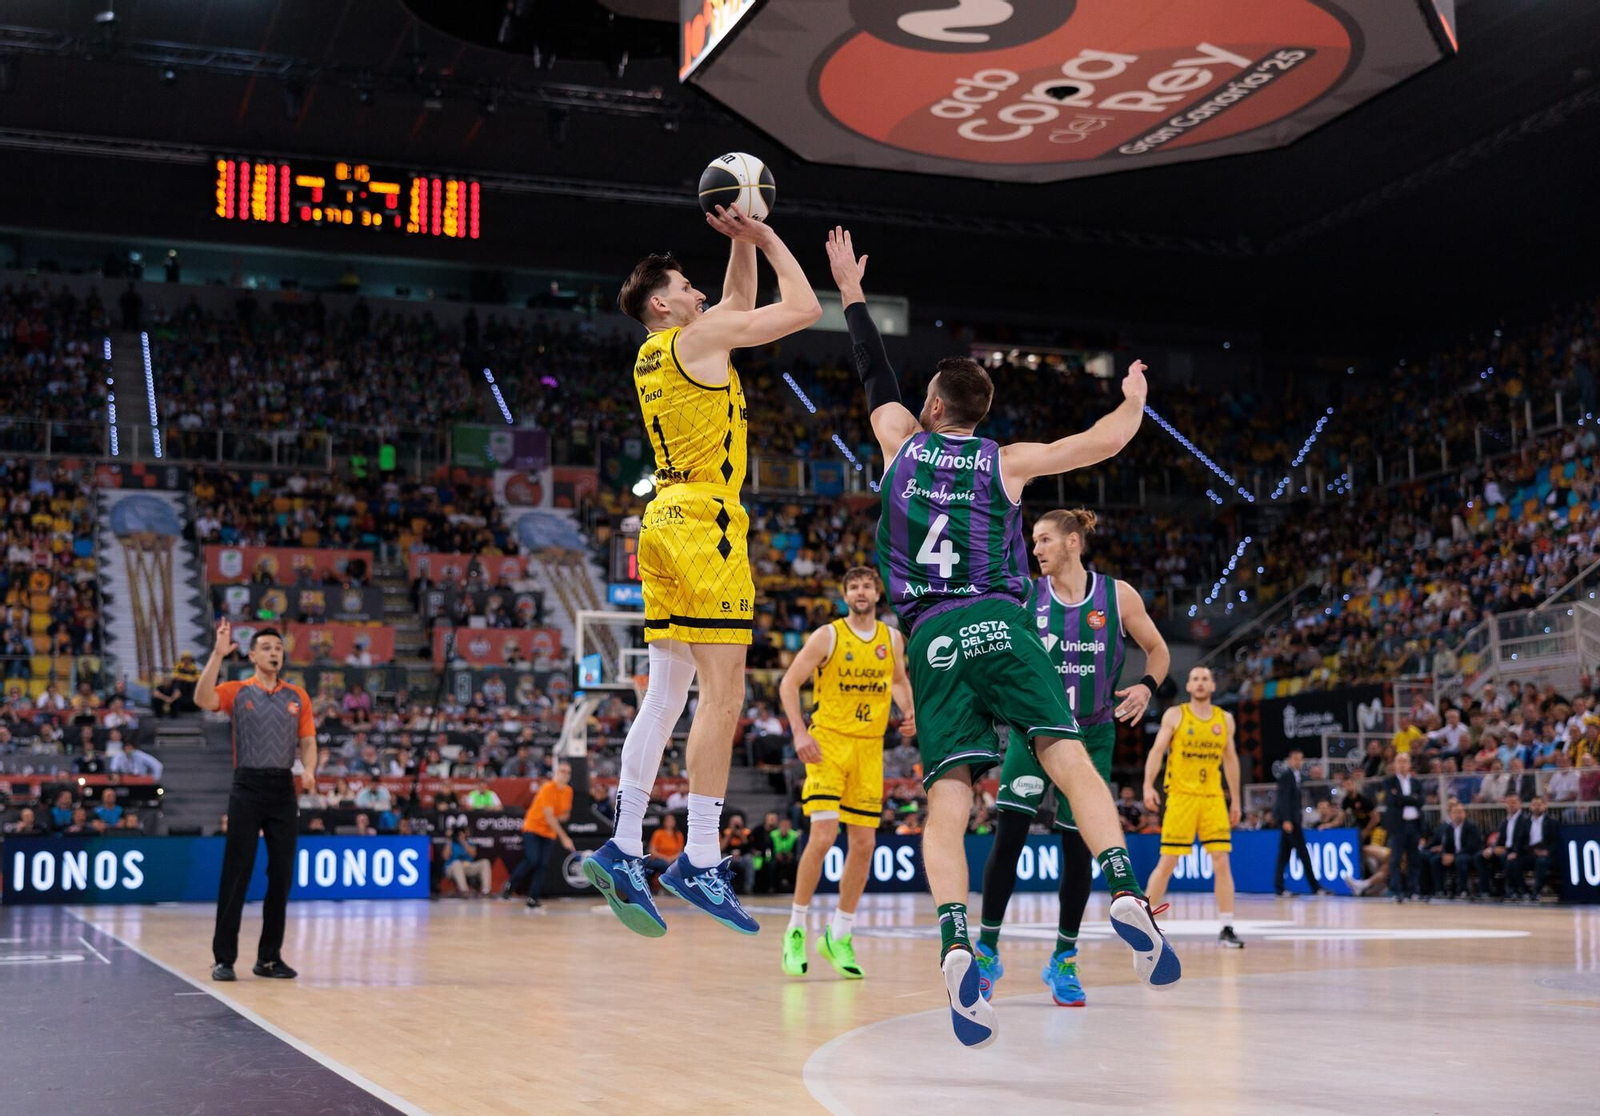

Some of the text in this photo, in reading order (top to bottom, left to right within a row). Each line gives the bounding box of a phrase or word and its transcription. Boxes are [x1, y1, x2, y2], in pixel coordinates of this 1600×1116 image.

[929, 68, 1019, 119] acb
[957, 48, 1139, 142] Copa
[1048, 43, 1253, 144] del Rey
[1118, 125, 1183, 155] Gran
[1169, 72, 1274, 128] Canaria
[652, 415, 672, 467] 1
[904, 442, 992, 471] Kalinoski
[902, 478, 976, 504] Benahavís
[915, 513, 960, 578] 4
[959, 620, 1010, 637] COSTA
[961, 631, 1012, 648] DEL SOL
[963, 641, 1012, 660] MÁLAGA
[1060, 640, 1105, 654] Unicaja
[838, 667, 852, 678] LA
[855, 703, 873, 722] 42
[13, 850, 144, 891] IONOS
[298, 848, 419, 887] IONOS
